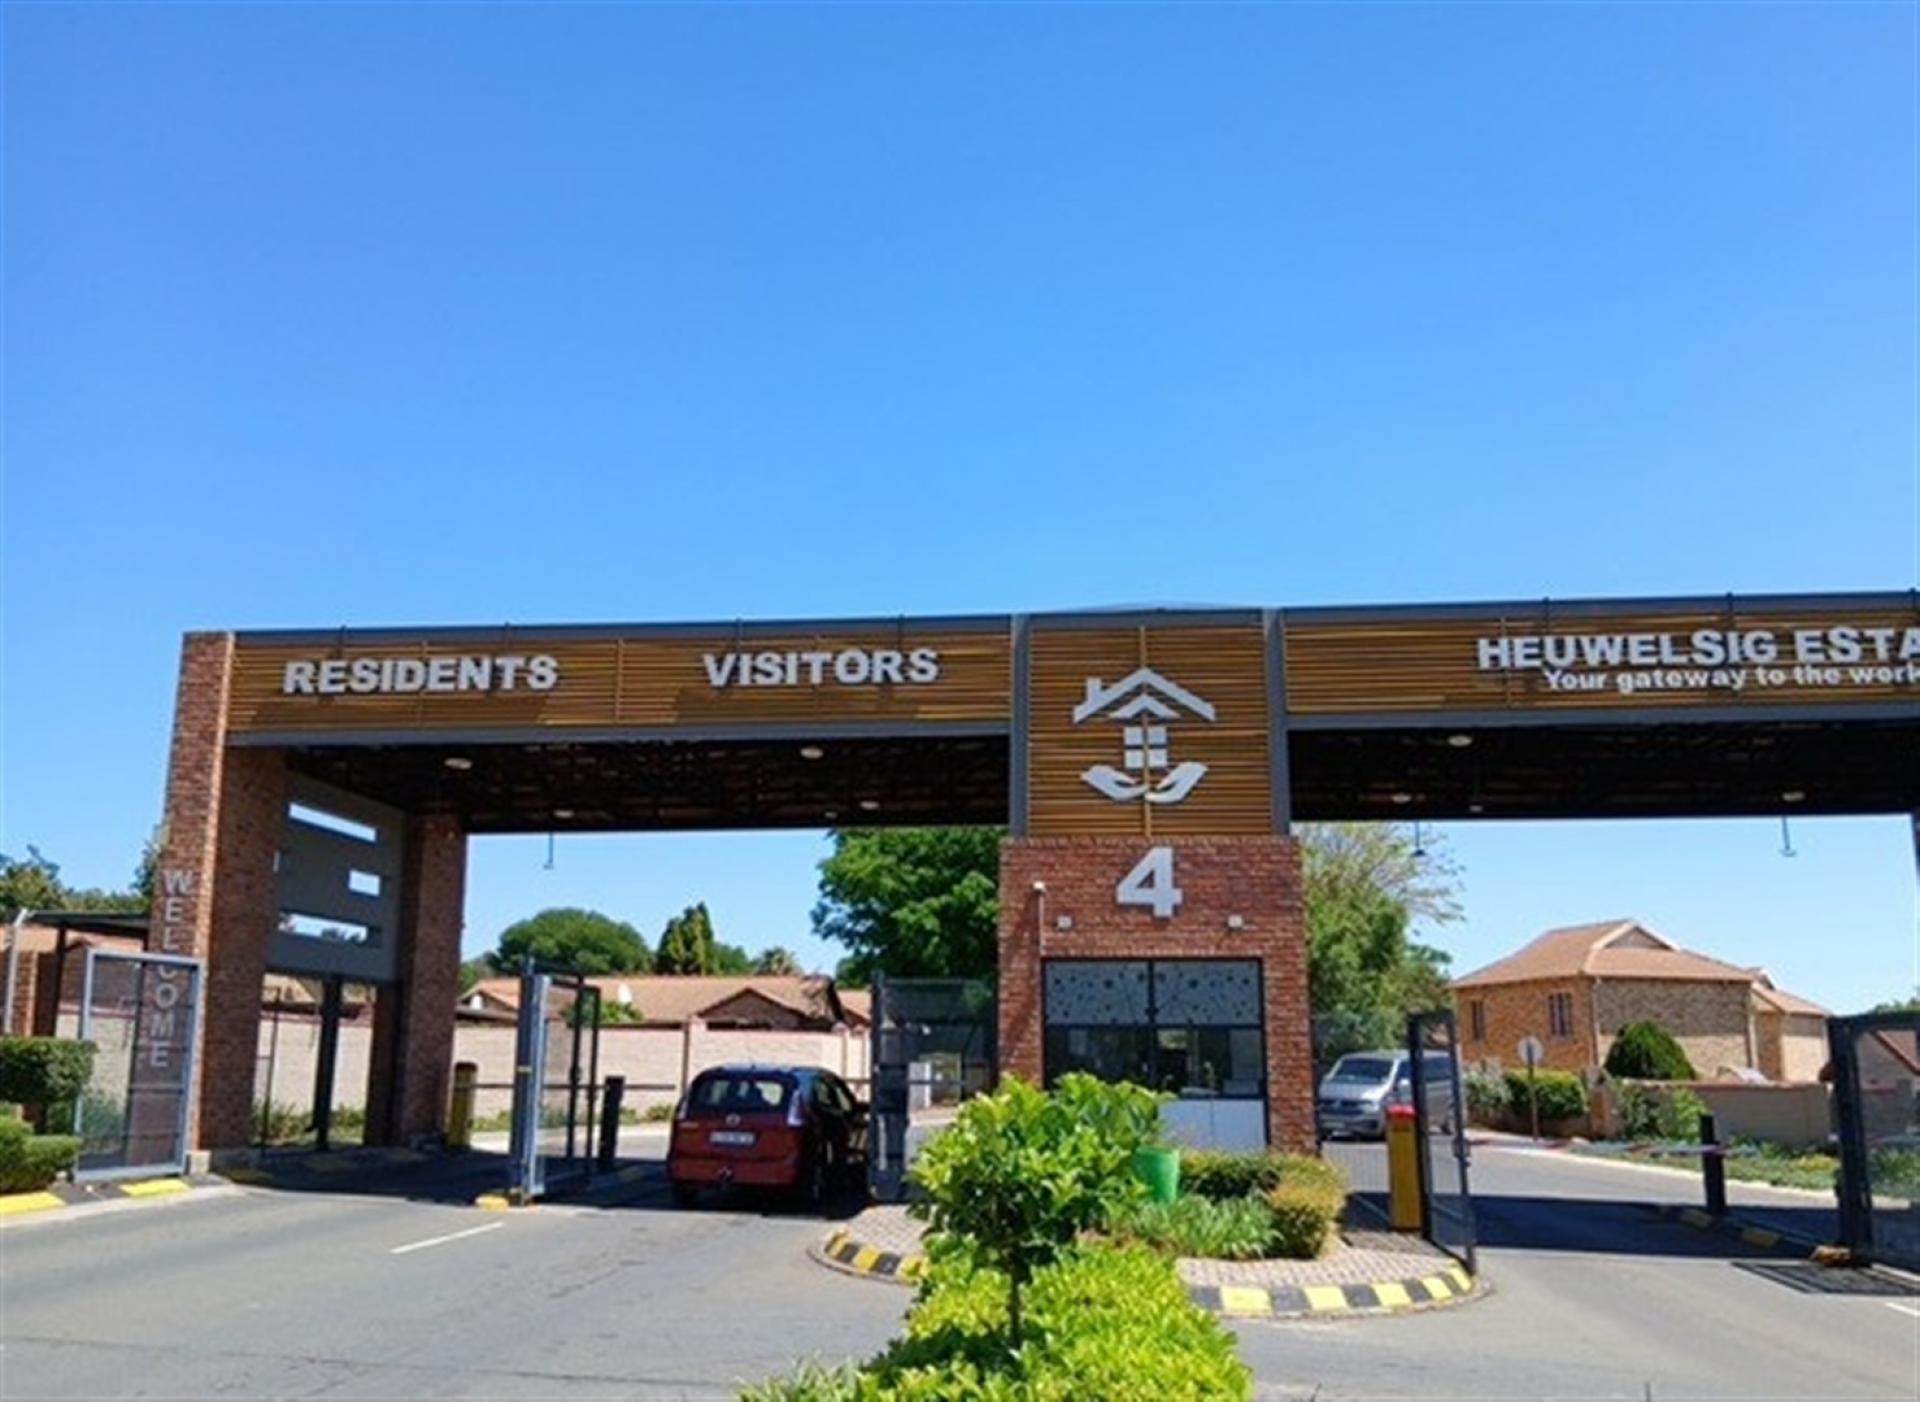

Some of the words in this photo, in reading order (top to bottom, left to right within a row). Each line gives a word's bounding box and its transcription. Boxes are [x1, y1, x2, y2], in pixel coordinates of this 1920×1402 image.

[1477, 629, 1777, 669] HEUWELSIG
[1794, 626, 1920, 663] ESTA
[283, 655, 559, 693] RESIDENTS
[703, 648, 939, 687] VISITORS
[1545, 669, 1608, 690] Your
[1616, 669, 1747, 695] gateway
[1755, 666, 1786, 685] to
[1794, 664, 1841, 685] the
[1116, 846, 1184, 918] 4
